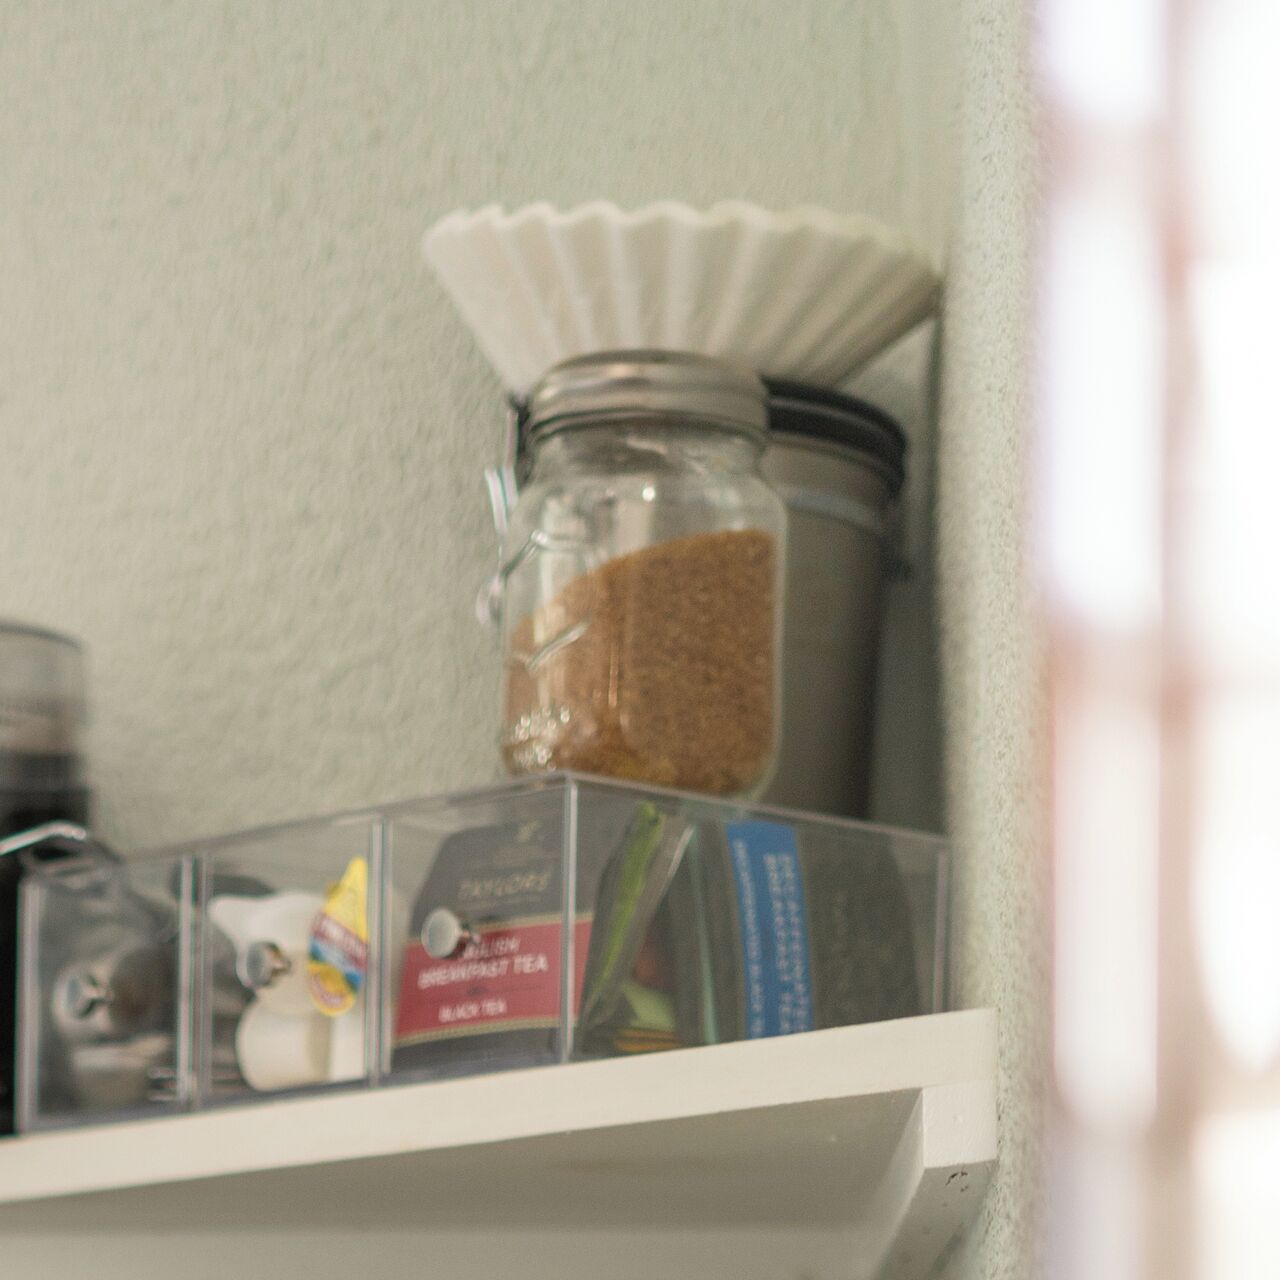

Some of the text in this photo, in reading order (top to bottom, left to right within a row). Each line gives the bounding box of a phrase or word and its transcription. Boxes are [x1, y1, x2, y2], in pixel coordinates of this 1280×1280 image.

[418, 953, 549, 989] BREAKFAST TEA
[438, 999, 507, 1024] BLACK TEA
